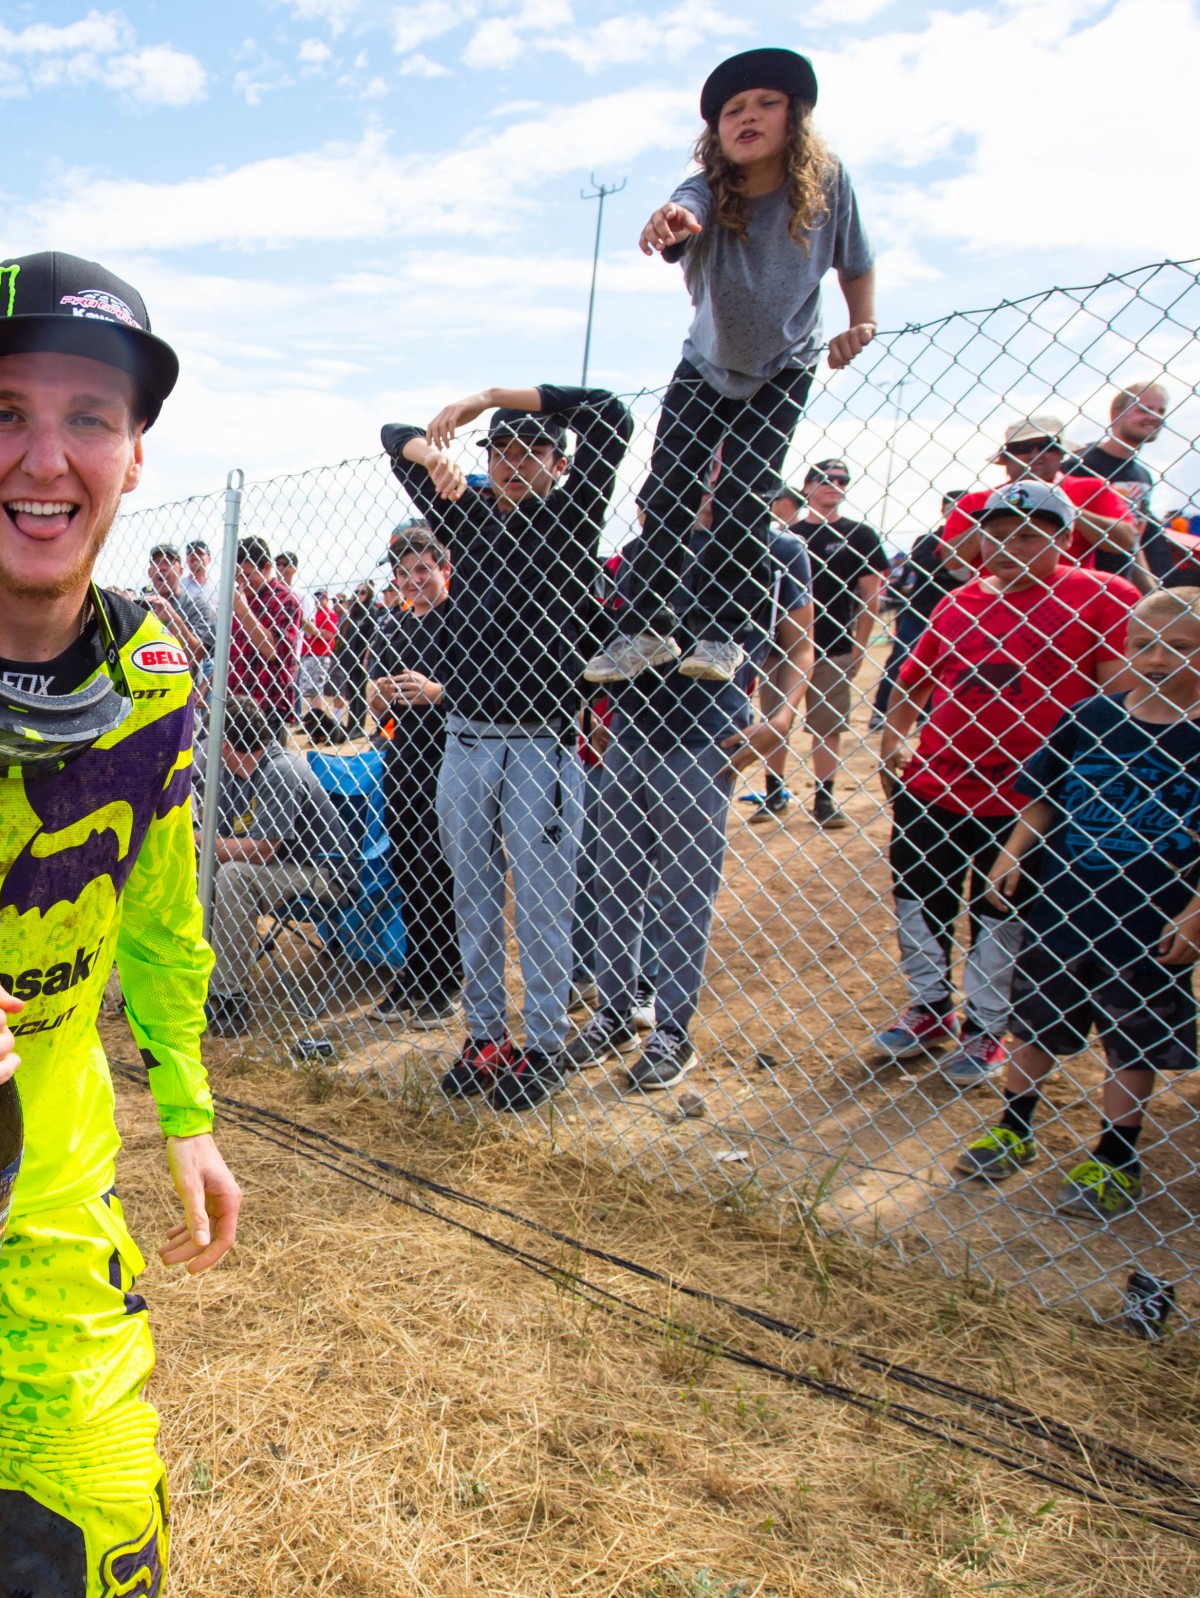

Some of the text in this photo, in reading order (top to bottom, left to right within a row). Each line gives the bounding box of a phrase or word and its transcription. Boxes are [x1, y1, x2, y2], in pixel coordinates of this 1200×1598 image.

[141, 651, 189, 666] BELL
[2, 671, 56, 697] FOX
[132, 688, 171, 700] OTT
